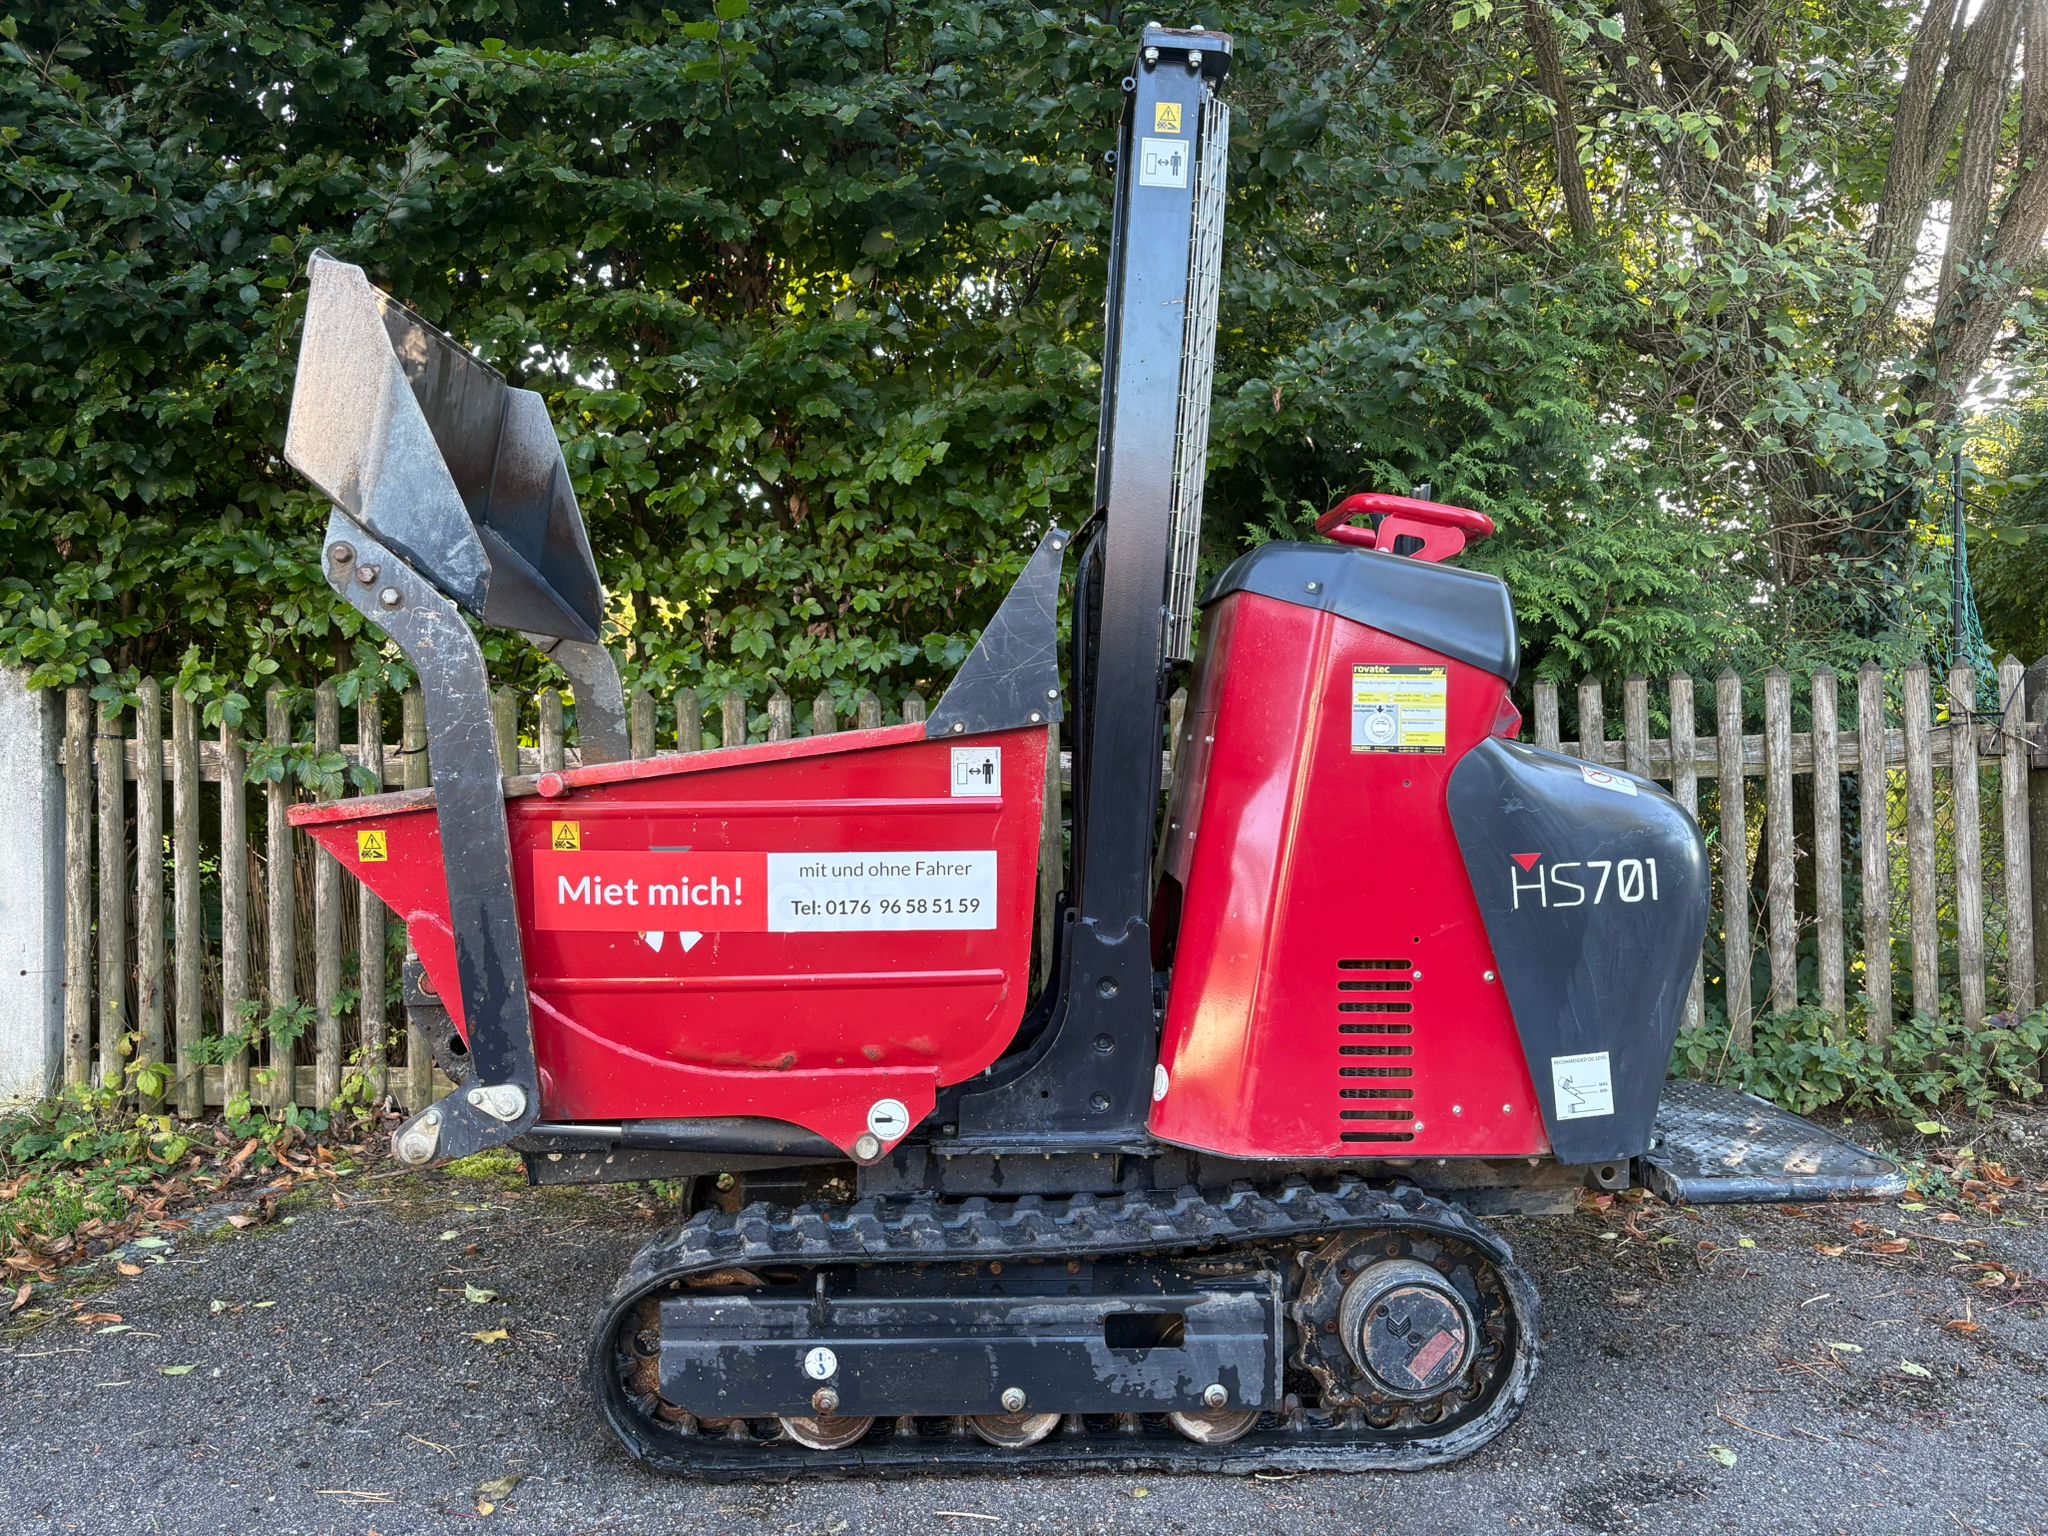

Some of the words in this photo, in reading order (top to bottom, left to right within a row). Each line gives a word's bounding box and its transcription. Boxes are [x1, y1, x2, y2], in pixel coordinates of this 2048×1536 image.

[1354, 665, 1390, 674] rovatec
[800, 862, 827, 878] mit
[831, 862, 864, 878] und
[868, 861, 911, 877] ohne
[915, 860, 973, 876] Fahrer
[559, 876, 638, 905] Miet
[649, 877, 742, 906] mich!
[1511, 857, 1659, 910] HS701
[791, 900, 821, 915] Tel:
[825, 899, 871, 915] 0176
[879, 899, 901, 914] 96
[906, 898, 928, 914] 58
[932, 898, 954, 914] 51
[958, 897, 980, 913] 59
[1554, 1057, 1587, 1066] RECOMMENDED
